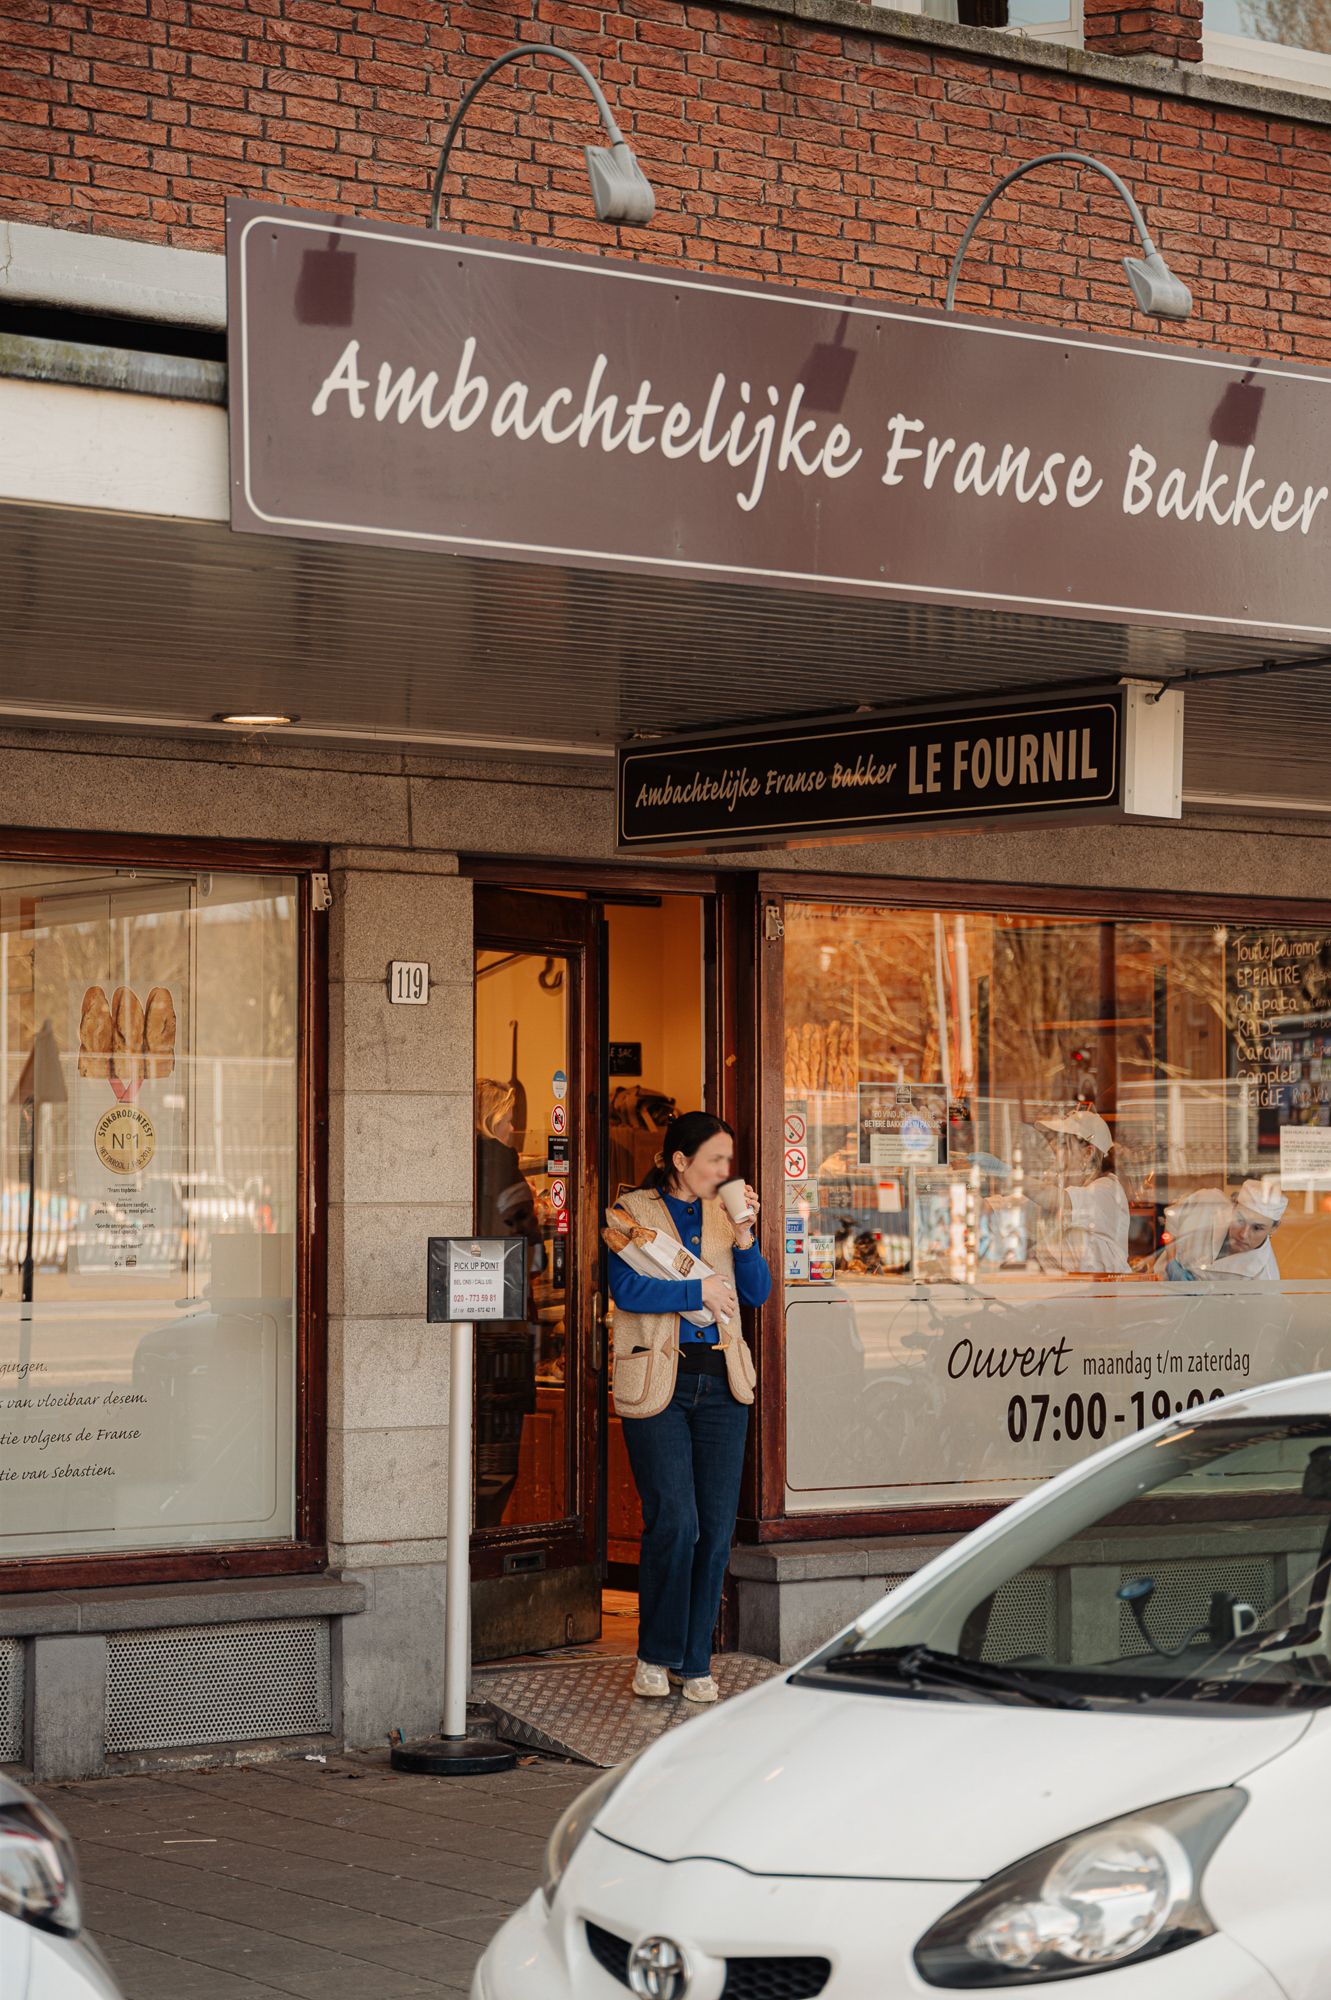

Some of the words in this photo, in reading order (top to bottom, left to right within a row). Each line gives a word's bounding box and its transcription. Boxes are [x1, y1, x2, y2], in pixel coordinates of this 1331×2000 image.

[312, 337, 862, 511] Ambachtelijke
[882, 414, 1103, 508] Franse
[1122, 439, 1329, 535] Bakker
[635, 768, 761, 812] Ambachtelijke
[765, 767, 827, 796] Franse
[831, 754, 897, 788] Bakker
[908, 744, 942, 795] LE
[953, 728, 1099, 791] FOURNIL
[397, 966, 423, 1000] 119
[98, 1109, 153, 1137] STOKBRODENTEST
[815, 1243, 830, 1251] VISA
[453, 1262, 470, 1270] PICK
[470, 1262, 480, 1270] UP
[480, 1262, 499, 1270] POINT
[469, 1294, 480, 1302] 773
[946, 1336, 1074, 1380] Ouvert
[1083, 1350, 1152, 1380] maandag
[1156, 1350, 1183, 1375] t/m
[1187, 1348, 1250, 1377] zaterdag
[7, 1399, 33, 1409] van
[37, 1393, 100, 1408] vloeibaar
[103, 1391, 148, 1405] desem.
[1007, 1388, 1226, 1443] 07:00-19:
[23, 1429, 72, 1450] volgens
[75, 1427, 93, 1441] de
[96, 1428, 142, 1441] Franse
[22, 1470, 49, 1480] van
